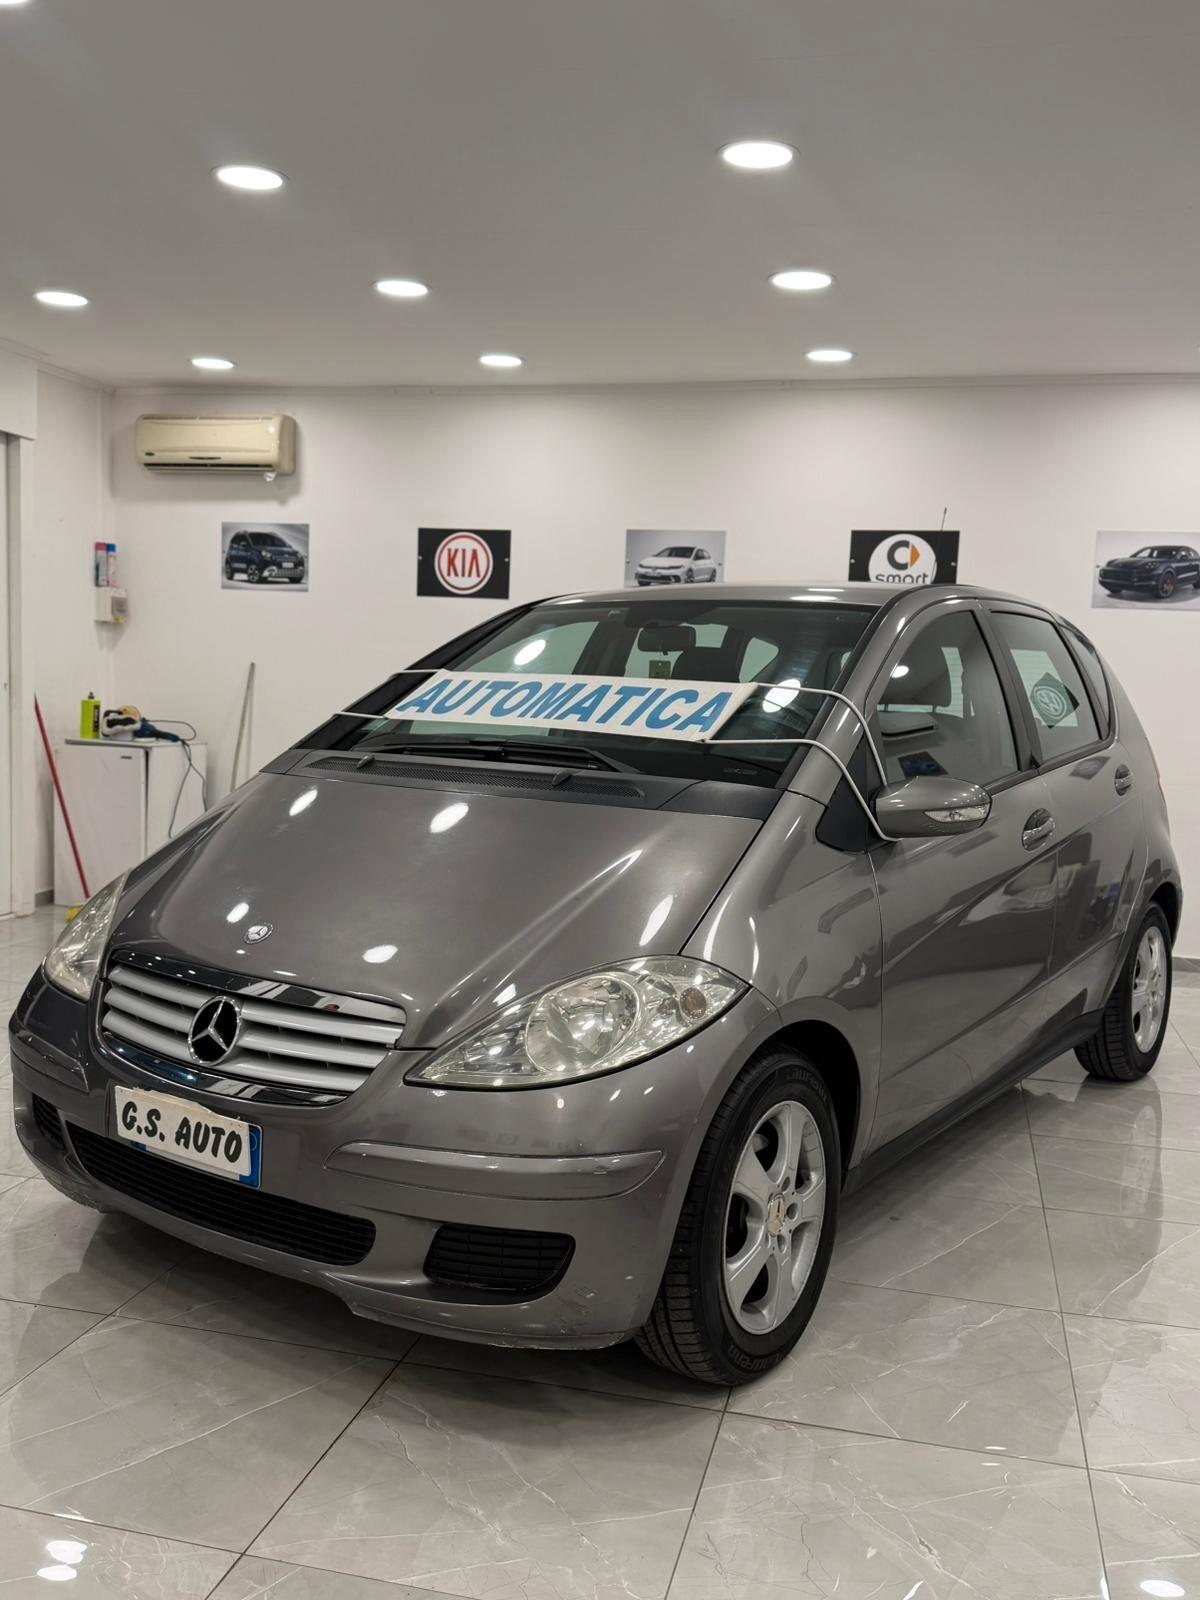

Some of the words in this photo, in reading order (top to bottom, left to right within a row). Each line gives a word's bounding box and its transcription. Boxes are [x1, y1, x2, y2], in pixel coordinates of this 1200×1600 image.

[446, 547, 481, 578] KIA
[875, 572, 929, 584] smart
[395, 678, 731, 734] AUTOMATICA
[122, 1101, 165, 1142] G.S.
[175, 1117, 242, 1162] AUTO
